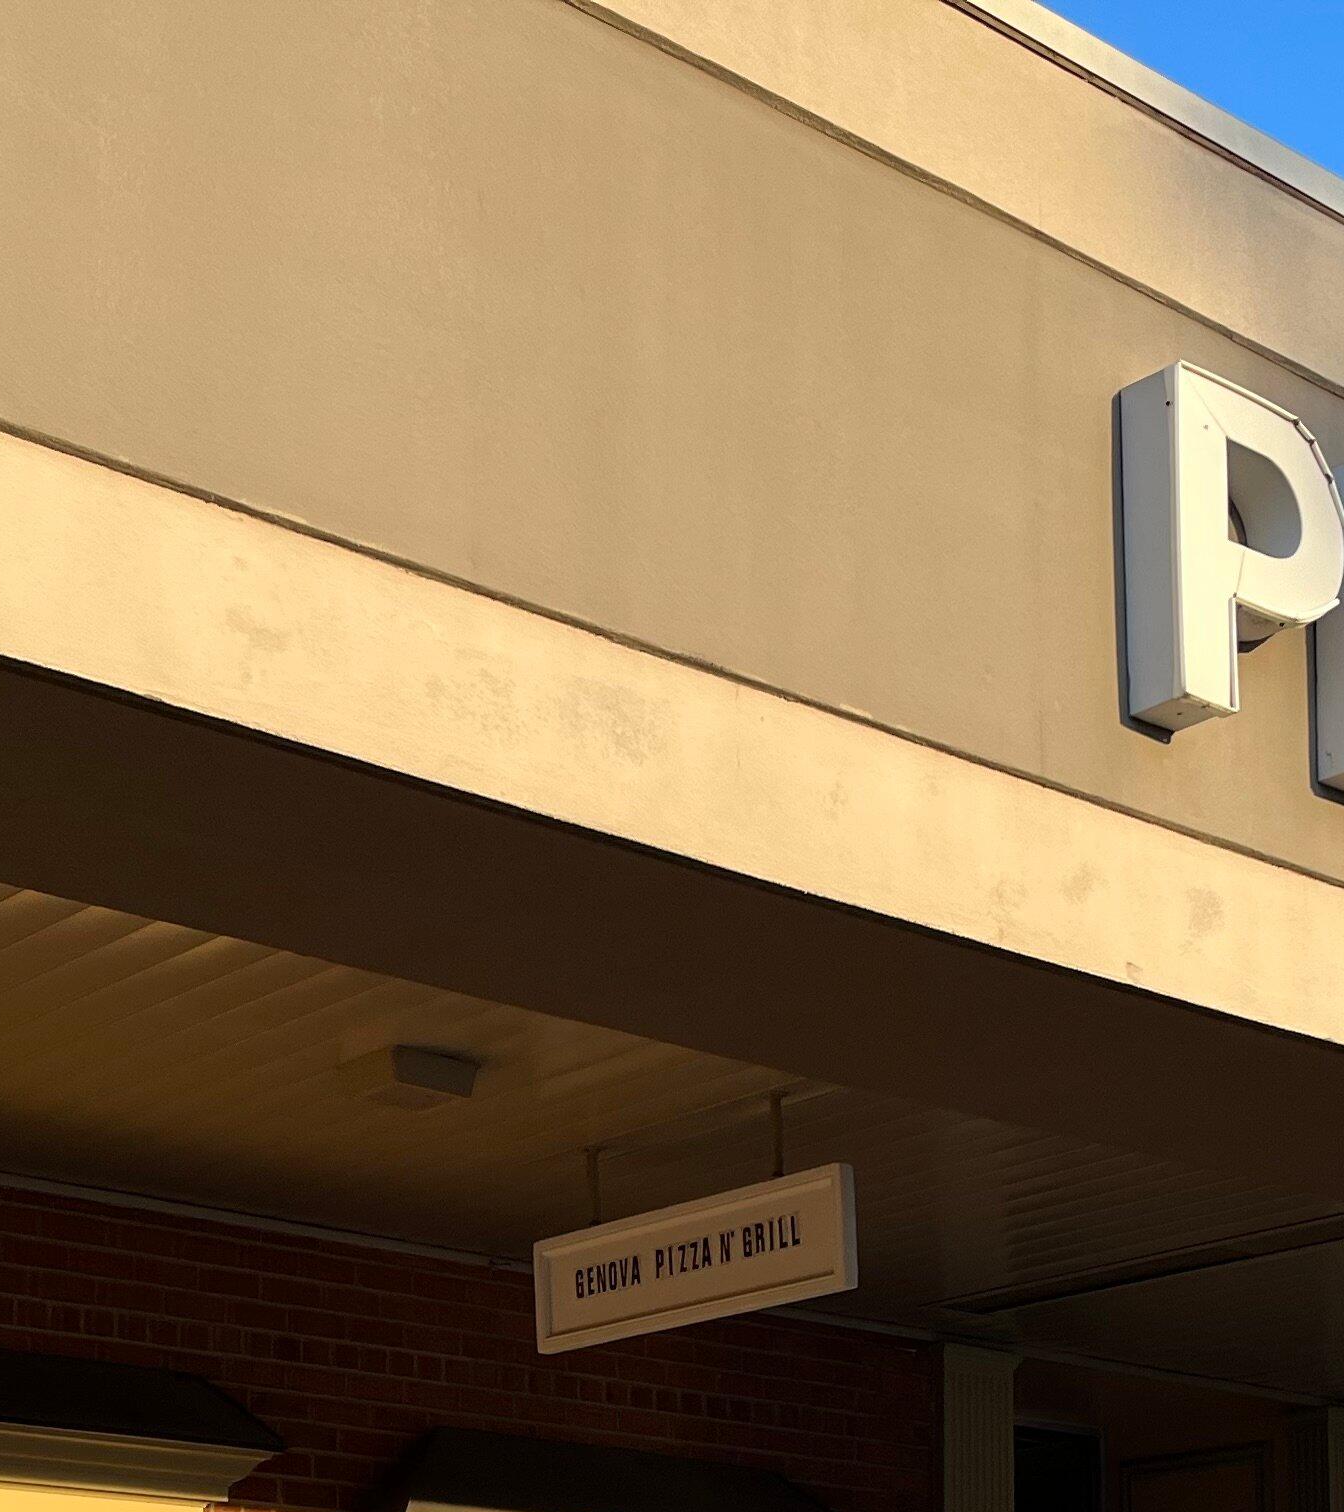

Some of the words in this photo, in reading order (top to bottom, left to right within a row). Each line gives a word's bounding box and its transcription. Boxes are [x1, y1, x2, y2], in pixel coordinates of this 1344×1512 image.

[575, 1255, 641, 1299] GENOVA
[655, 1236, 712, 1279] PIZZA
[742, 1215, 801, 1258] GRILL
